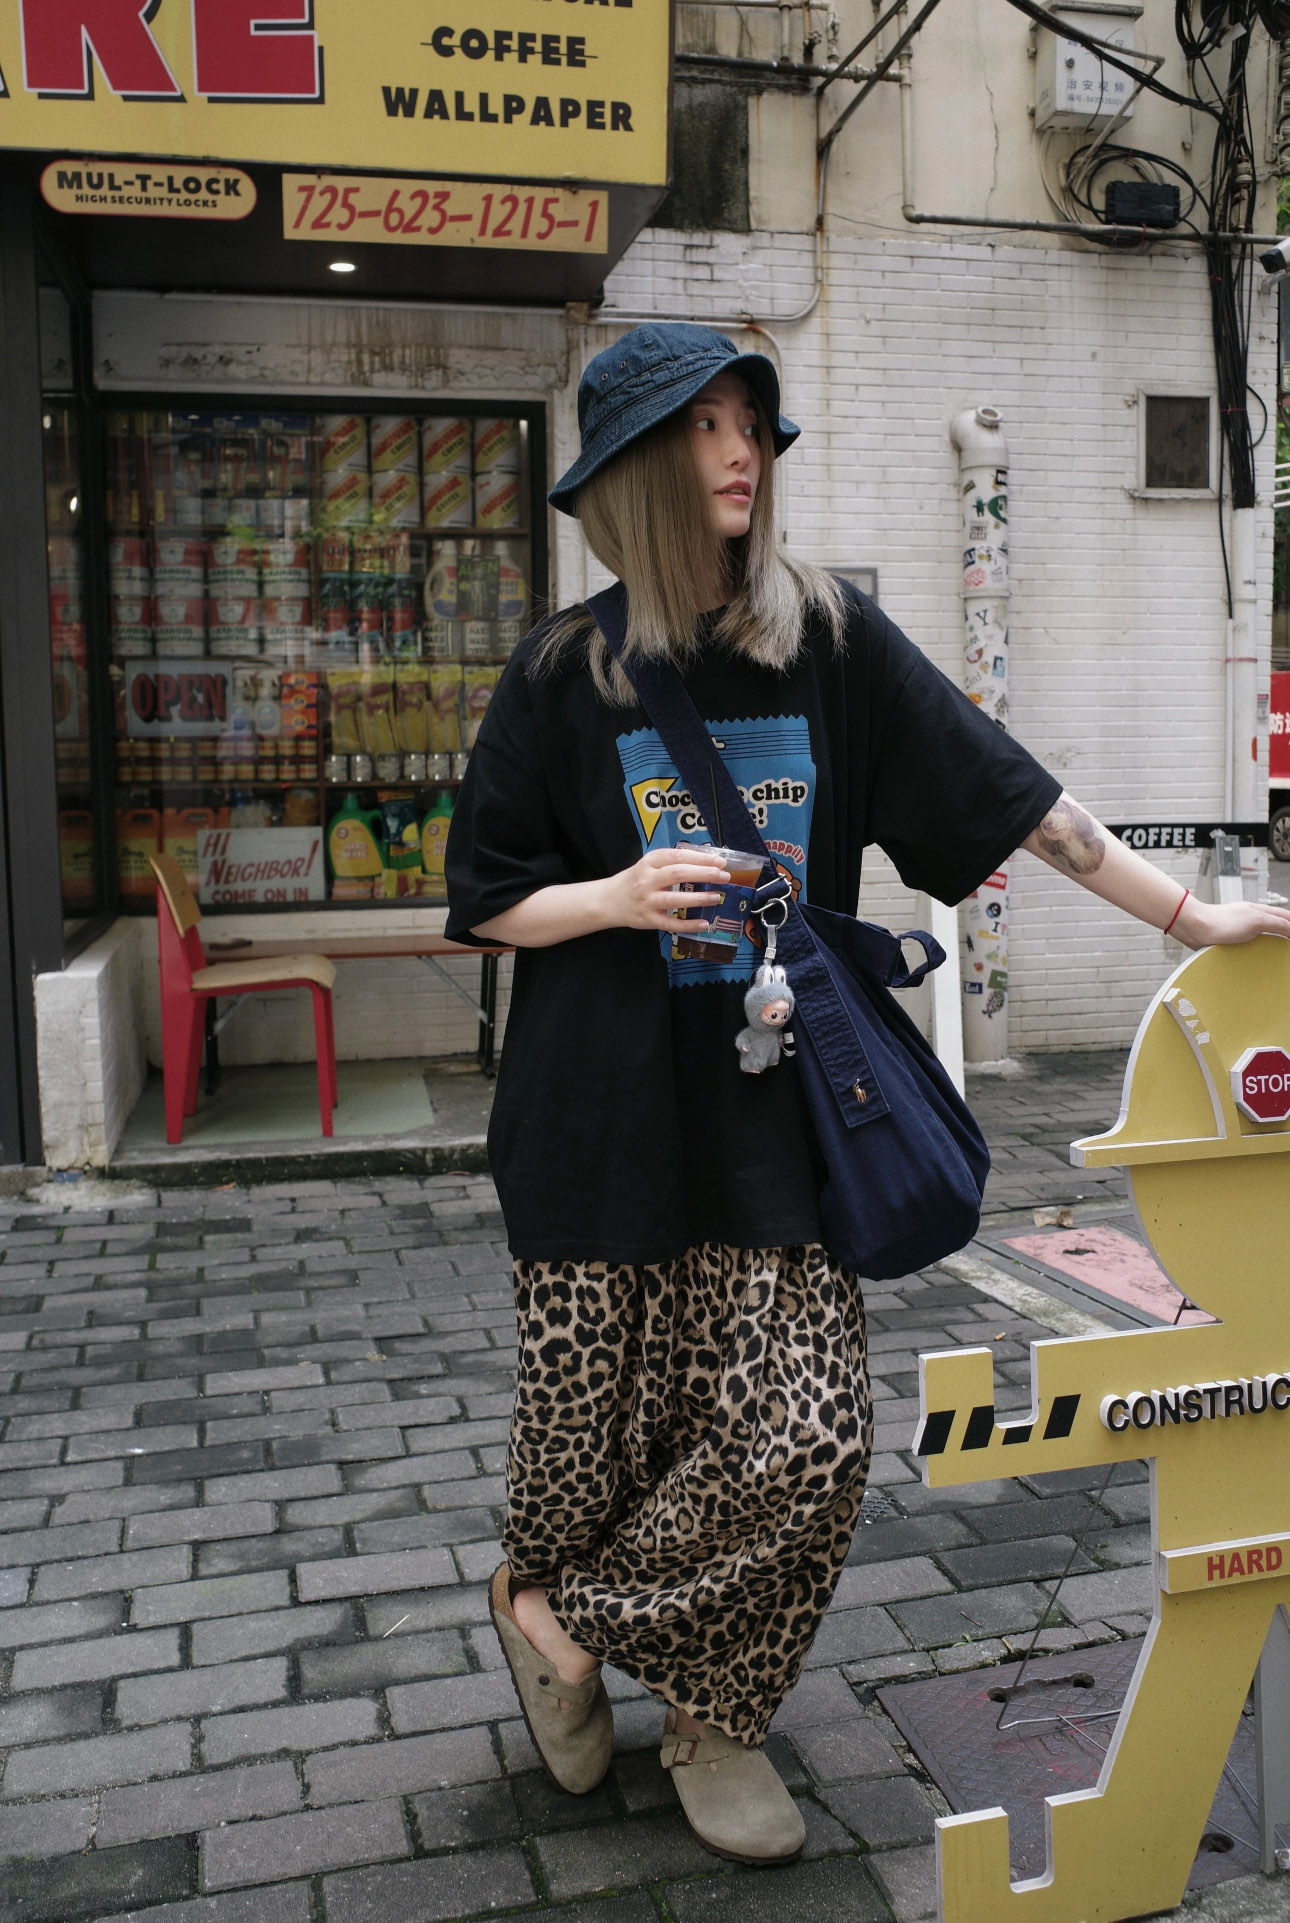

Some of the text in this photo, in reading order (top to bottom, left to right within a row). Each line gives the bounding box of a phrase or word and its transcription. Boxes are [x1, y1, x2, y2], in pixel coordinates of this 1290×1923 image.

[431, 26, 586, 68] COFFEE
[381, 86, 634, 132] WALLPAPER
[57, 170, 242, 197] MUL-T-LOCK
[75, 193, 218, 209] HIGH SECURITY LOCKS
[292, 184, 600, 243] 725-623-1215-1
[131, 672, 228, 723] OPEN
[752, 781, 806, 803] chip
[202, 832, 231, 858] HI
[765, 840, 805, 864] nappily
[1121, 826, 1196, 848] COFFEE
[206, 839, 320, 886] NEIGHBOR!
[212, 887, 309, 904] COME ON IN
[1103, 1375, 1290, 1432] CONSTRUC
[1207, 1546, 1283, 1581] HARD
